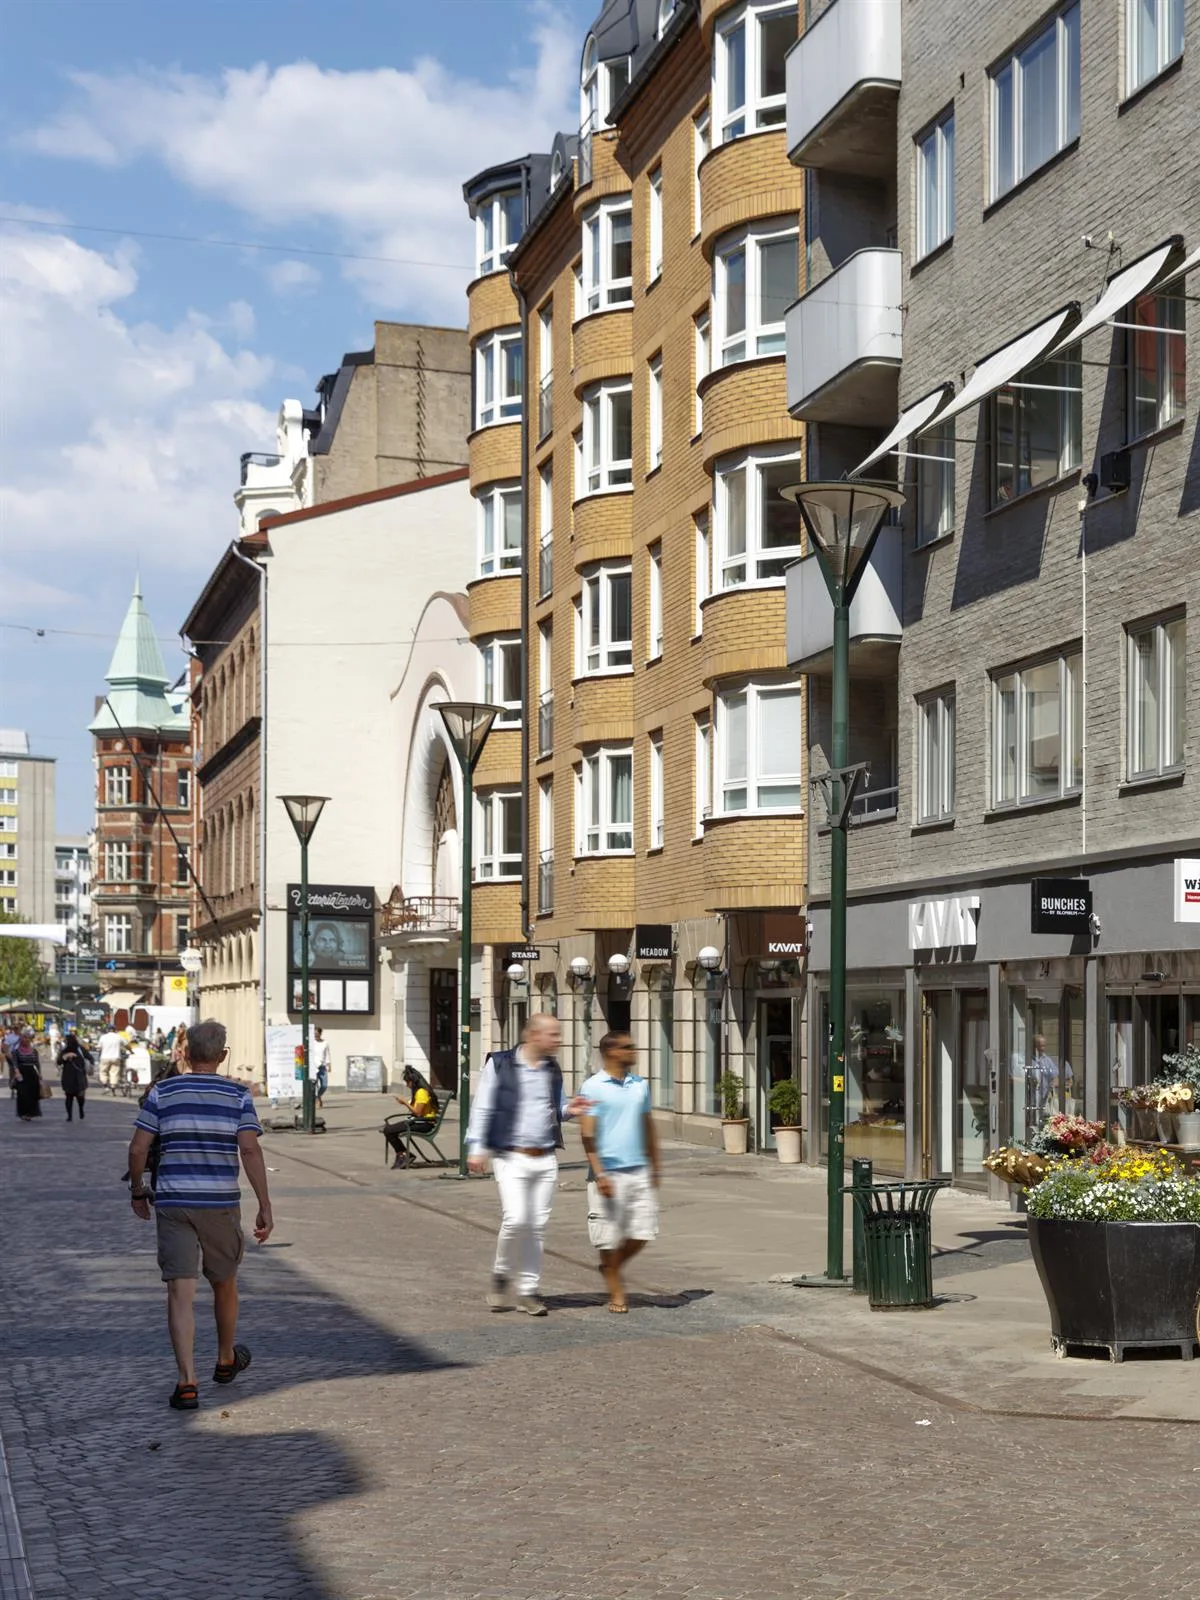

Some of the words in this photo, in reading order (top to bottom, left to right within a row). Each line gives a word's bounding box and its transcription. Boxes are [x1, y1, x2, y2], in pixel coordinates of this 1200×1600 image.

[1041, 897, 1086, 911] BUNCHES
[640, 948, 669, 957] MEADOW
[768, 943, 803, 953] KAVAT
[1040, 960, 1050, 977] 24
